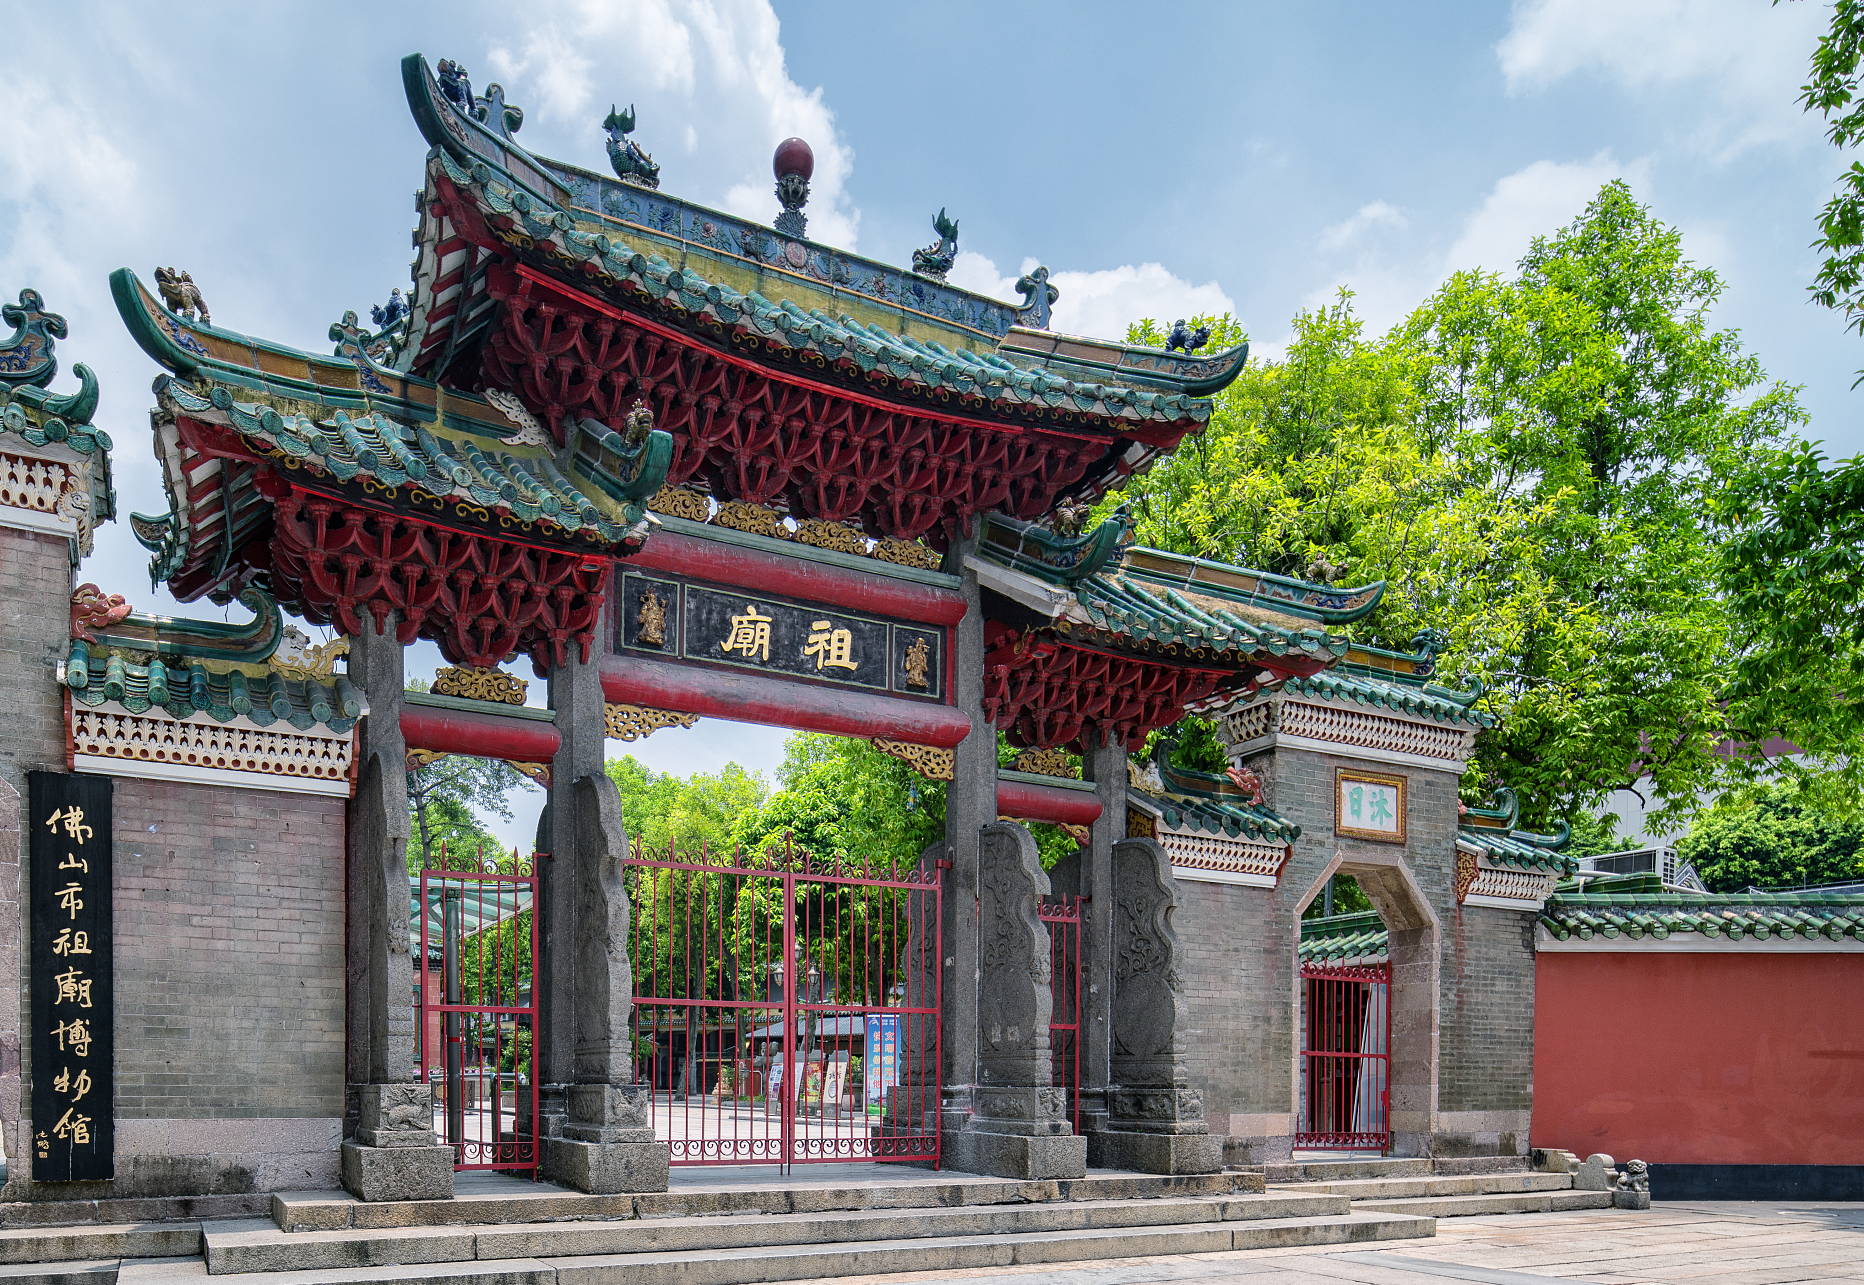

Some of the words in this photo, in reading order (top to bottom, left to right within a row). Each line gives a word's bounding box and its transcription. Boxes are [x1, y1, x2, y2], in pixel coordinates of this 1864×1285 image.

[720, 605, 859, 672] 祖廟
[1349, 786, 1393, 827] 沐日
[884, 1031, 895, 1087] 文明游天下
